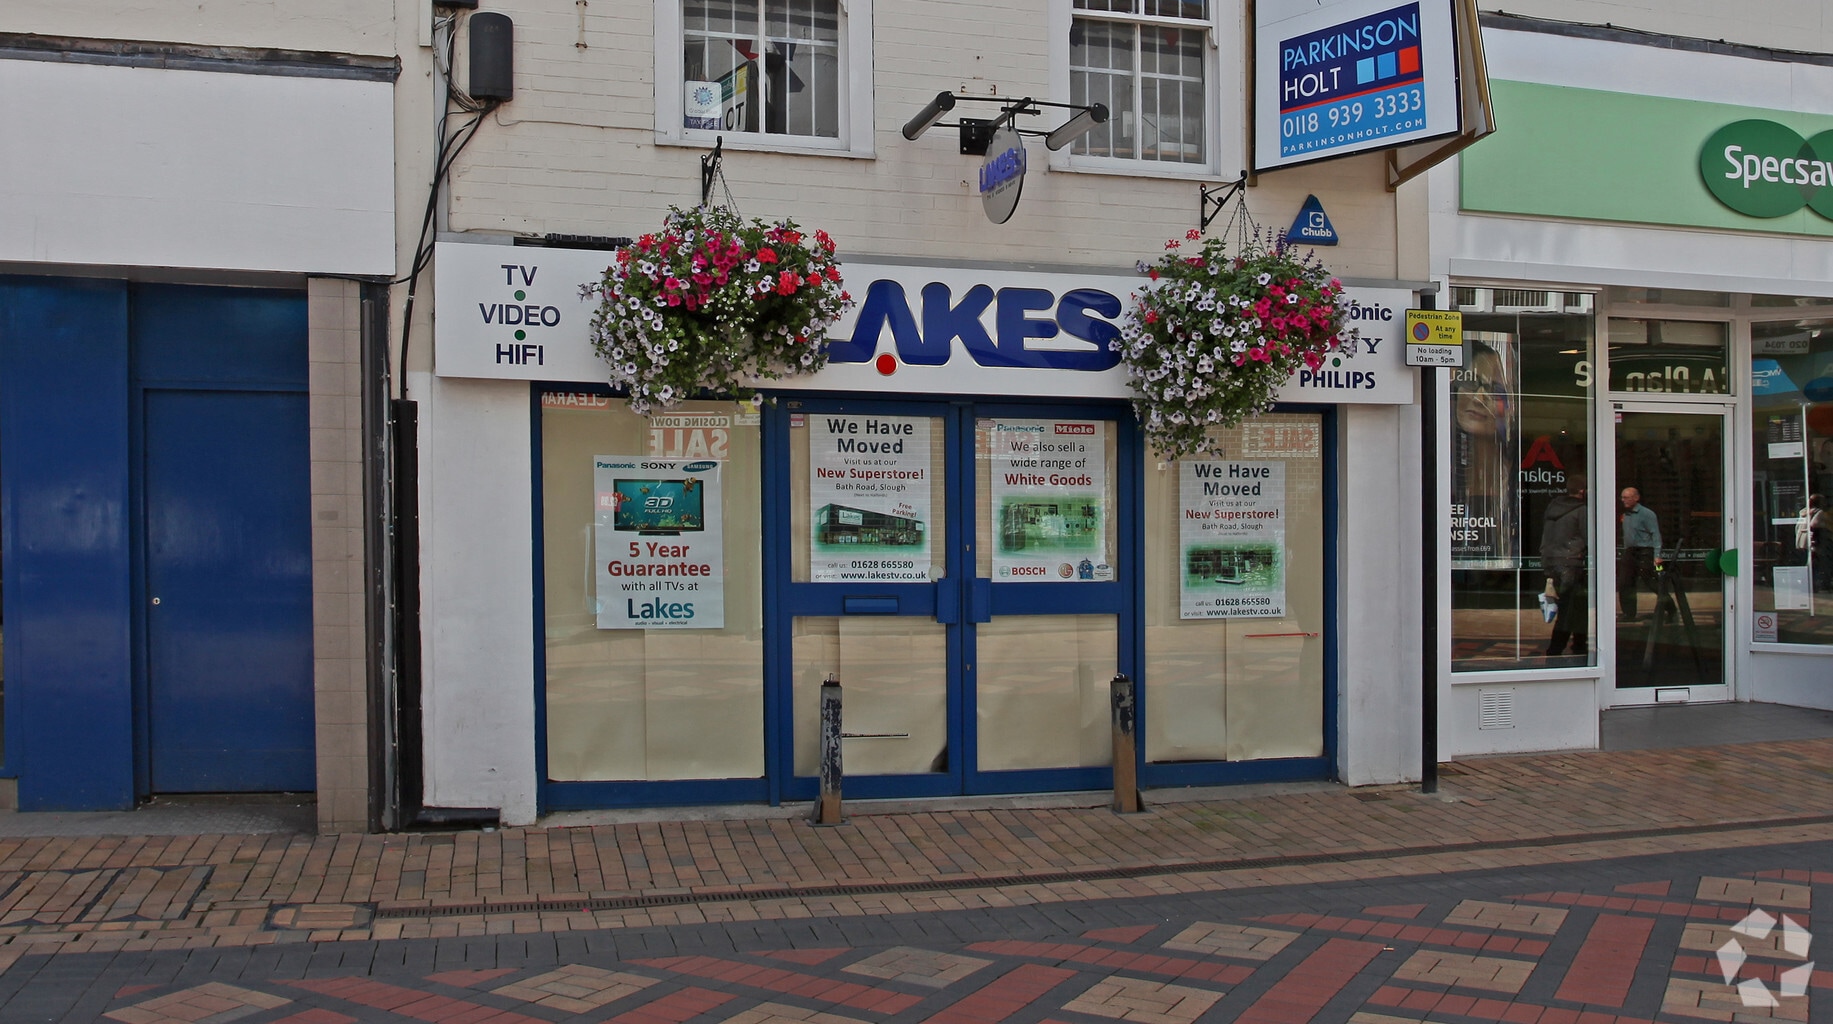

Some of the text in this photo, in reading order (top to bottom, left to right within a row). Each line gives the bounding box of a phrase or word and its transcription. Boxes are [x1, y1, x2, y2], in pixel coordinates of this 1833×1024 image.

[1283, 12, 1418, 72] PARKINSON
[1284, 66, 1341, 102] HOLT
[1283, 89, 1422, 138] 0118 939 3333
[1283, 118, 1423, 154] PARKINSONHOLT.COM
[1302, 227, 1332, 237] Chubb
[501, 264, 538, 286] TV
[479, 303, 561, 327] VIDEO
[1409, 313, 1460, 322] Pedestrian Zone
[819, 279, 1123, 372] AKES
[1445, 326, 1456, 334] any
[496, 343, 544, 365] HIFI
[1417, 347, 1452, 356] No loading
[1440, 356, 1455, 364] 5pm
[1300, 370, 1376, 390] PHILIPS
[827, 418, 913, 435] We Have
[1055, 425, 1095, 434] Miele
[838, 438, 903, 454] Moved
[1011, 442, 1085, 452] We also sell a
[874, 458, 882, 466] at
[1010, 458, 1086, 471] wide range of
[817, 467, 924, 481] New Superstore!
[1195, 464, 1270, 478] We Have
[1005, 474, 1092, 486] White Goods
[855, 483, 878, 491] Road,
[880, 483, 906, 492] Slough
[1203, 481, 1261, 496] Moved
[644, 496, 674, 508] 3D
[1186, 508, 1279, 521] New Superstore!
[1220, 523, 1239, 531] Road,
[1241, 523, 1263, 531] Slough
[629, 542, 690, 557] 5 Year
[608, 560, 711, 576] Guarantee
[851, 560, 879, 569] 01628
[881, 560, 914, 569] 665580
[840, 570, 927, 580] www.lakestv.co.uk
[1012, 567, 1046, 576] BOSCH
[621, 581, 698, 591] with all TVs at
[628, 597, 695, 619] Lakes
[1215, 598, 1240, 607] 01628
[1241, 597, 1270, 606] 665580
[1206, 607, 1281, 617] www.lakestv.co.uk
